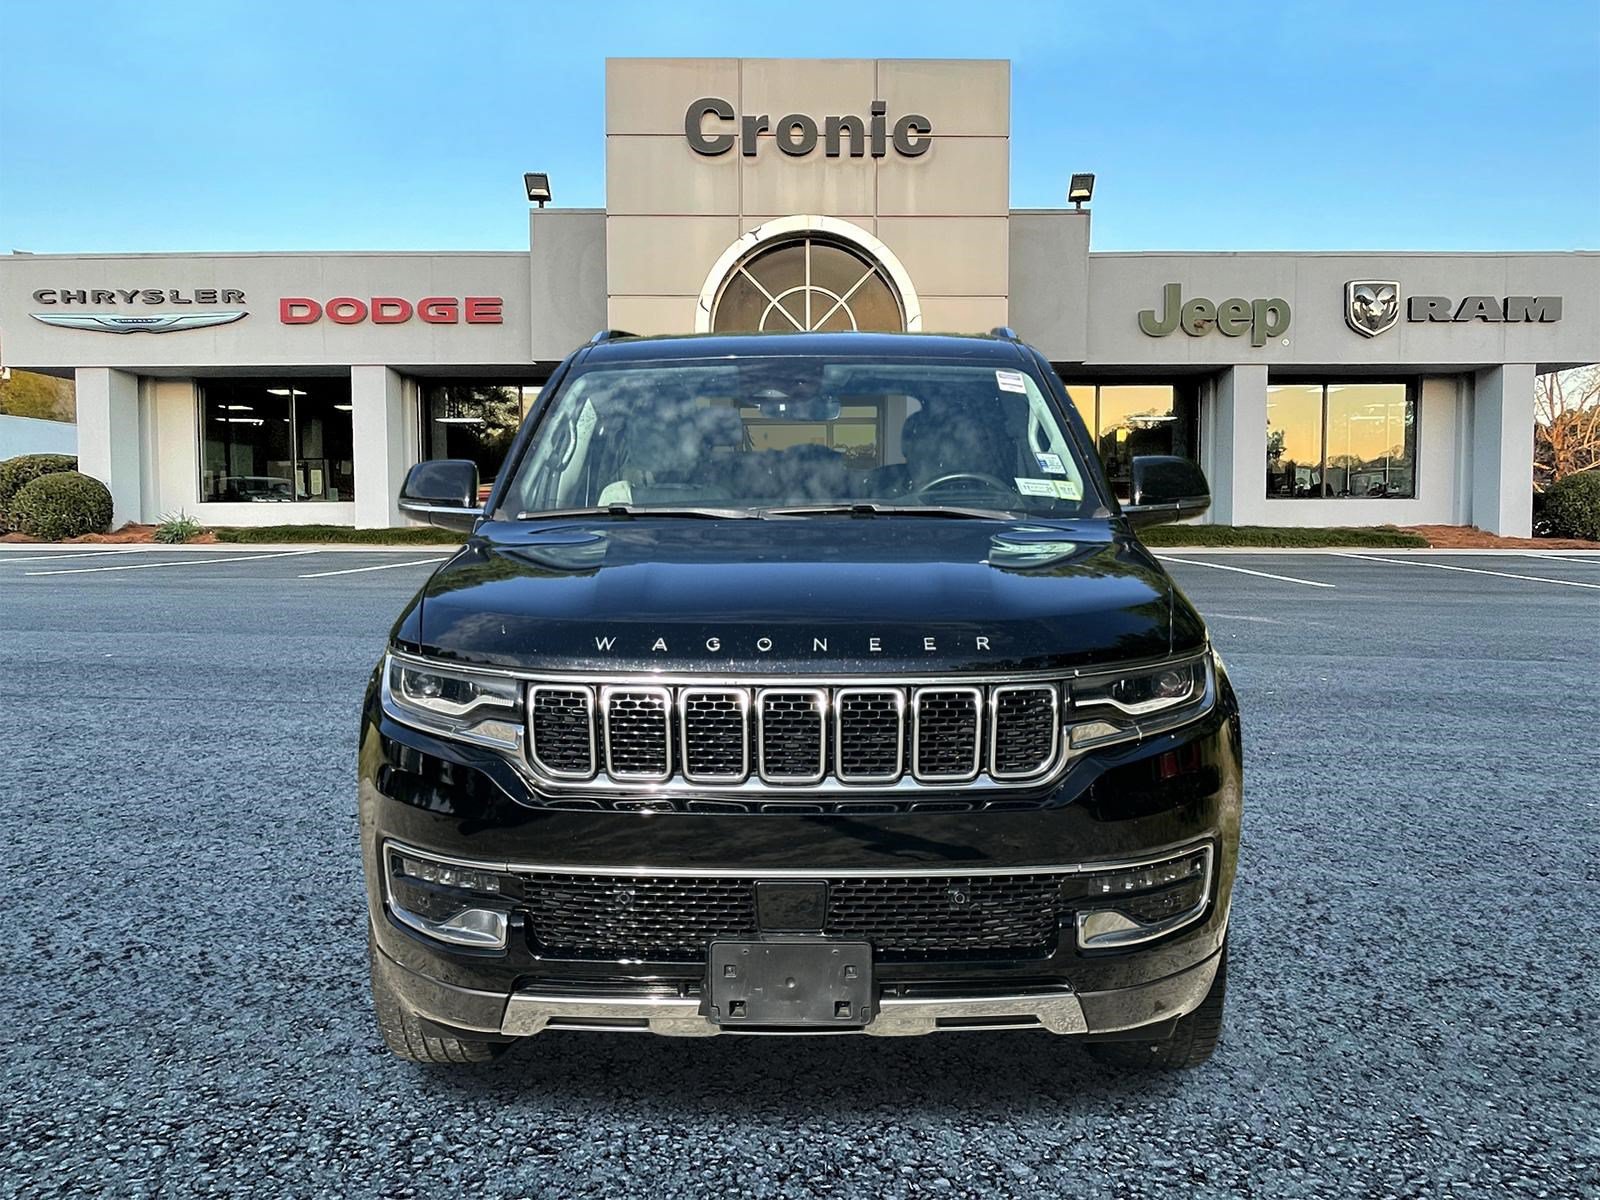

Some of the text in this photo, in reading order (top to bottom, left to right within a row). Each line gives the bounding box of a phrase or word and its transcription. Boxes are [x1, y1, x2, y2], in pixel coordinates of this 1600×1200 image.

[685, 97, 932, 157] Cronic
[32, 289, 246, 304] CHRYSLER
[1406, 296, 1563, 323] RAM
[279, 297, 503, 324] DODGE
[1138, 283, 1291, 347] Jeep
[595, 636, 991, 653] WAGONEER
